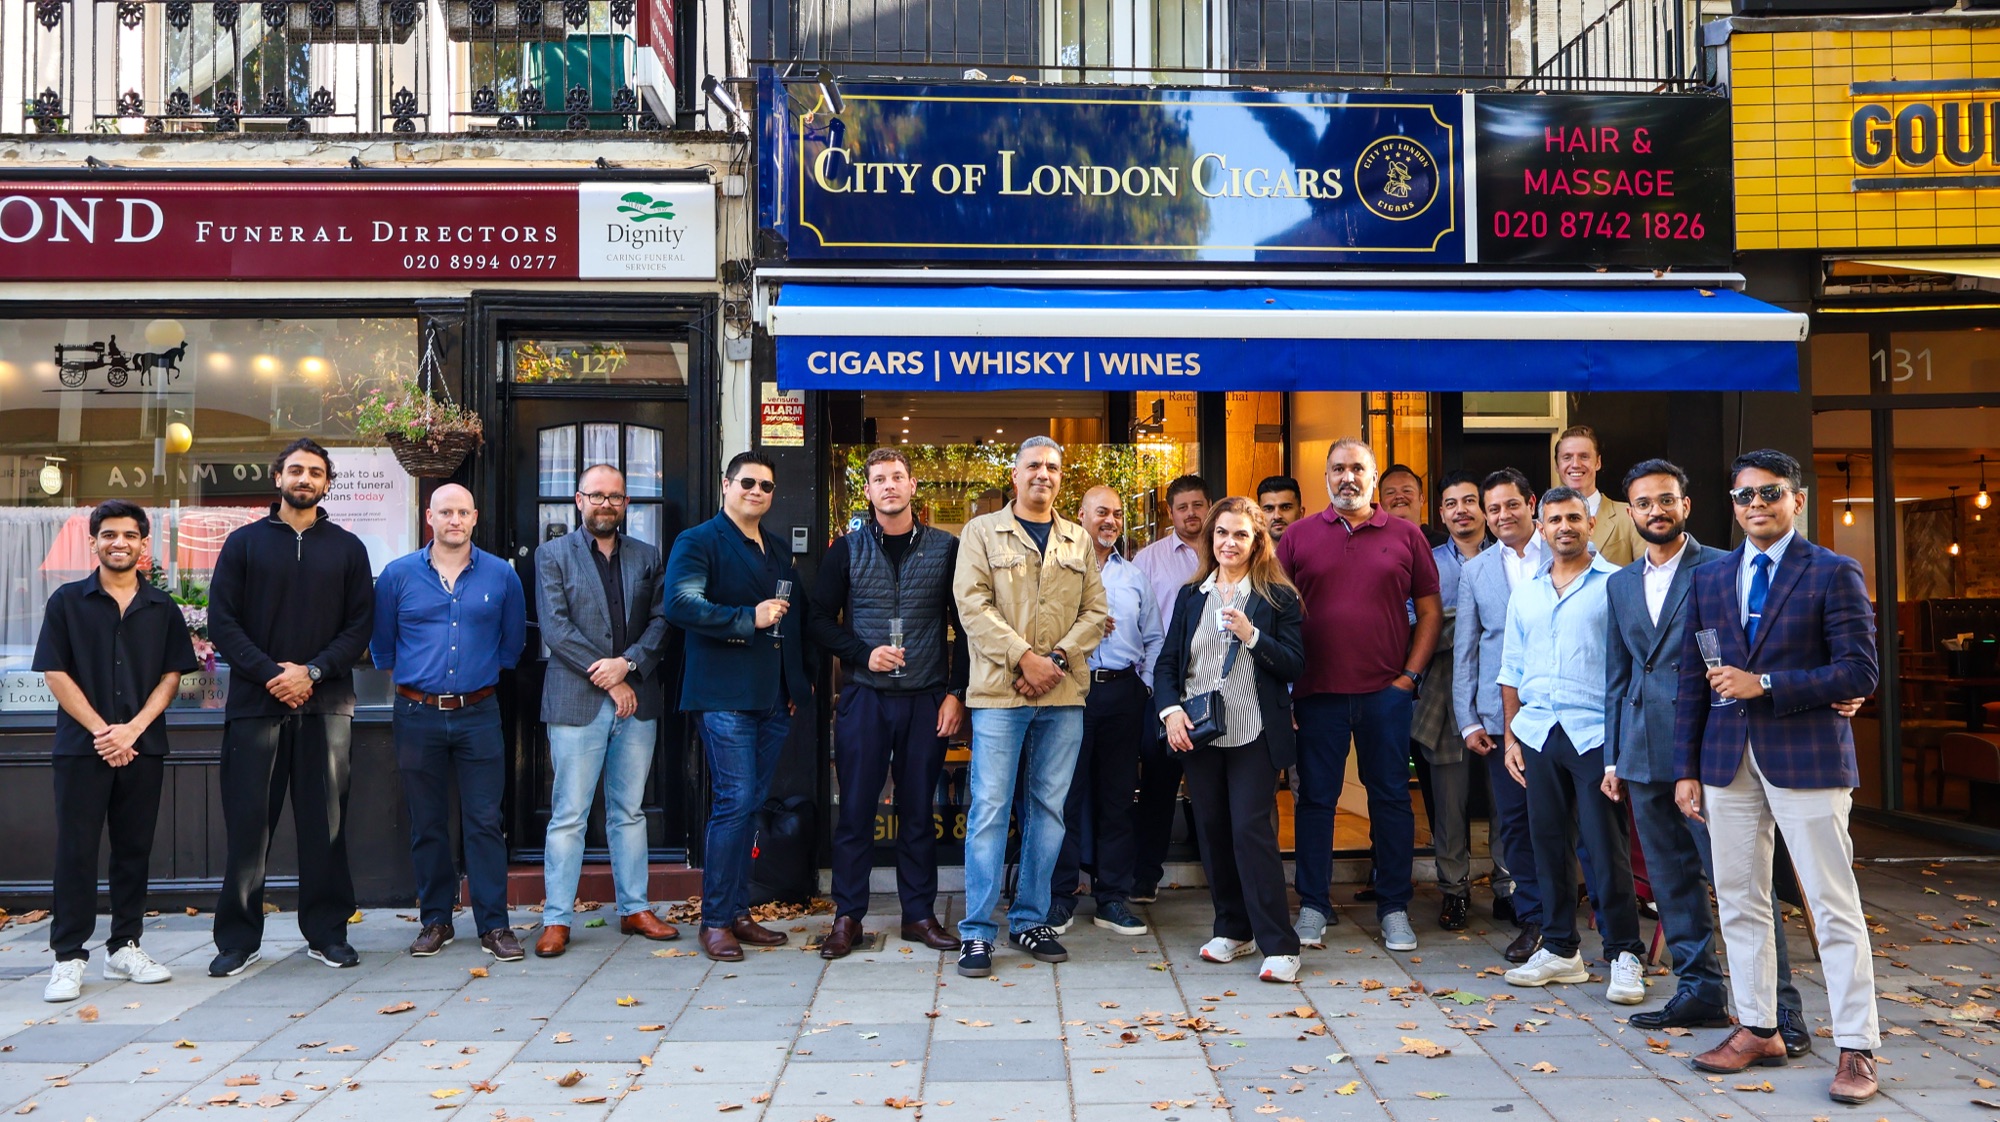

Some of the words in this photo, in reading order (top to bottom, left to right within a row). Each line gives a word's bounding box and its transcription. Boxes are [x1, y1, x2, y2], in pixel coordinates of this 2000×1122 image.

[1544, 126, 1620, 153] HAIR
[1632, 127, 1652, 153] &
[1851, 102, 2000, 168] GOU
[1363, 149, 1380, 169] CITY
[1382, 143, 1395, 152] OF
[1398, 143, 1429, 167] LONDON
[814, 147, 922, 193] CITY
[932, 163, 986, 194] OF
[998, 150, 1179, 197] LONDON
[1191, 153, 1343, 199] CIGARS
[1524, 168, 1674, 197] MASSAGE
[1377, 200, 1415, 212] CIGARS
[195, 221, 353, 243] FUNERAL
[371, 221, 557, 243] DIRECTORS
[1494, 211, 1547, 238] 020
[1560, 211, 1631, 239] 8742
[1642, 212, 1705, 240] 1826
[607, 224, 684, 249] Dignity
[403, 255, 440, 269] 020
[450, 255, 500, 270] 8994
[510, 255, 557, 269] 0277
[606, 253, 642, 262] CARING
[644, 253, 686, 262] FUNERAL
[625, 263, 667, 271] SERVICES
[580, 354, 621, 373] 127
[807, 351, 924, 375] CIGARS
[949, 351, 1075, 376] WHISKY
[1099, 353, 1201, 377] WINES
[1871, 348, 1932, 382] 131
[763, 405, 803, 415] ALARM
[358, 470, 369, 479] to
[373, 470, 384, 479] us
[357, 481, 393, 489] funeral
[354, 492, 385, 502] today
[201, 690, 223, 700] 130
